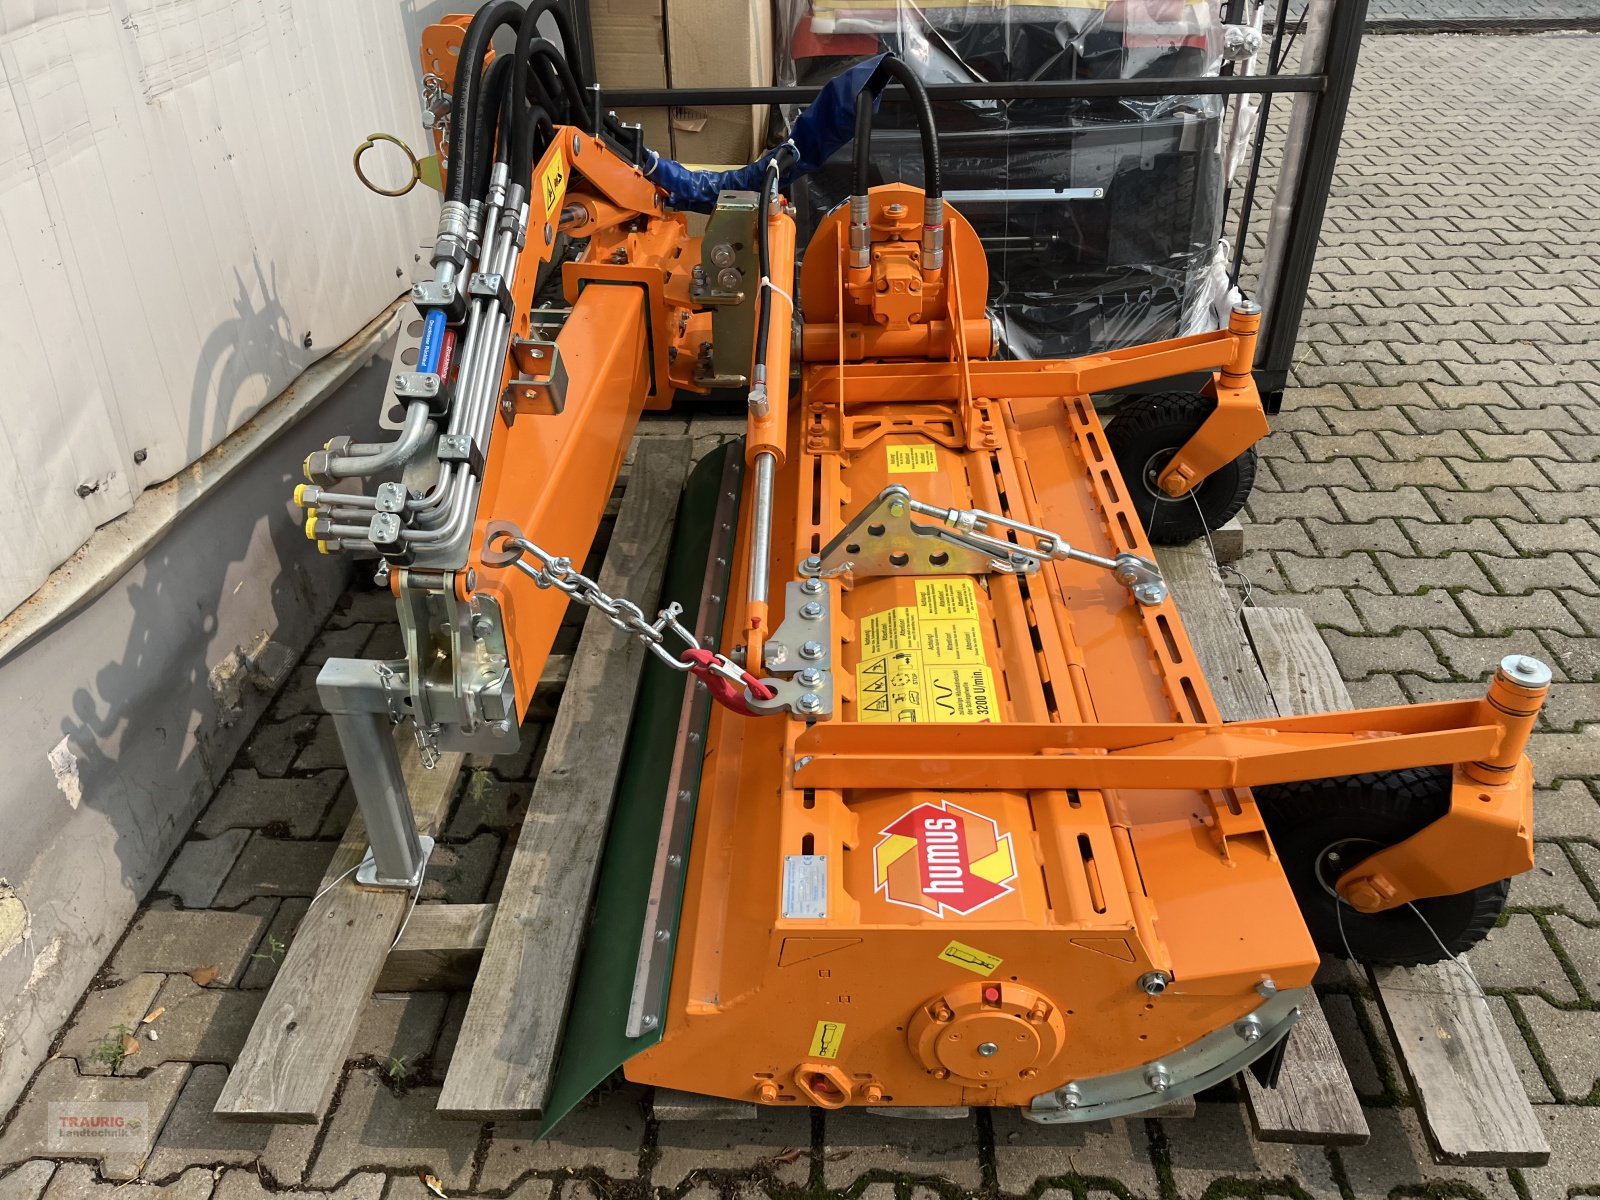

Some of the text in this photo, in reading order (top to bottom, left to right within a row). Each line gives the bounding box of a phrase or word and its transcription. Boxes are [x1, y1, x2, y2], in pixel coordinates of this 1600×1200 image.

[971, 669, 986, 693] U/min.
[974, 696, 989, 714] 3200
[923, 818, 964, 893] humus
